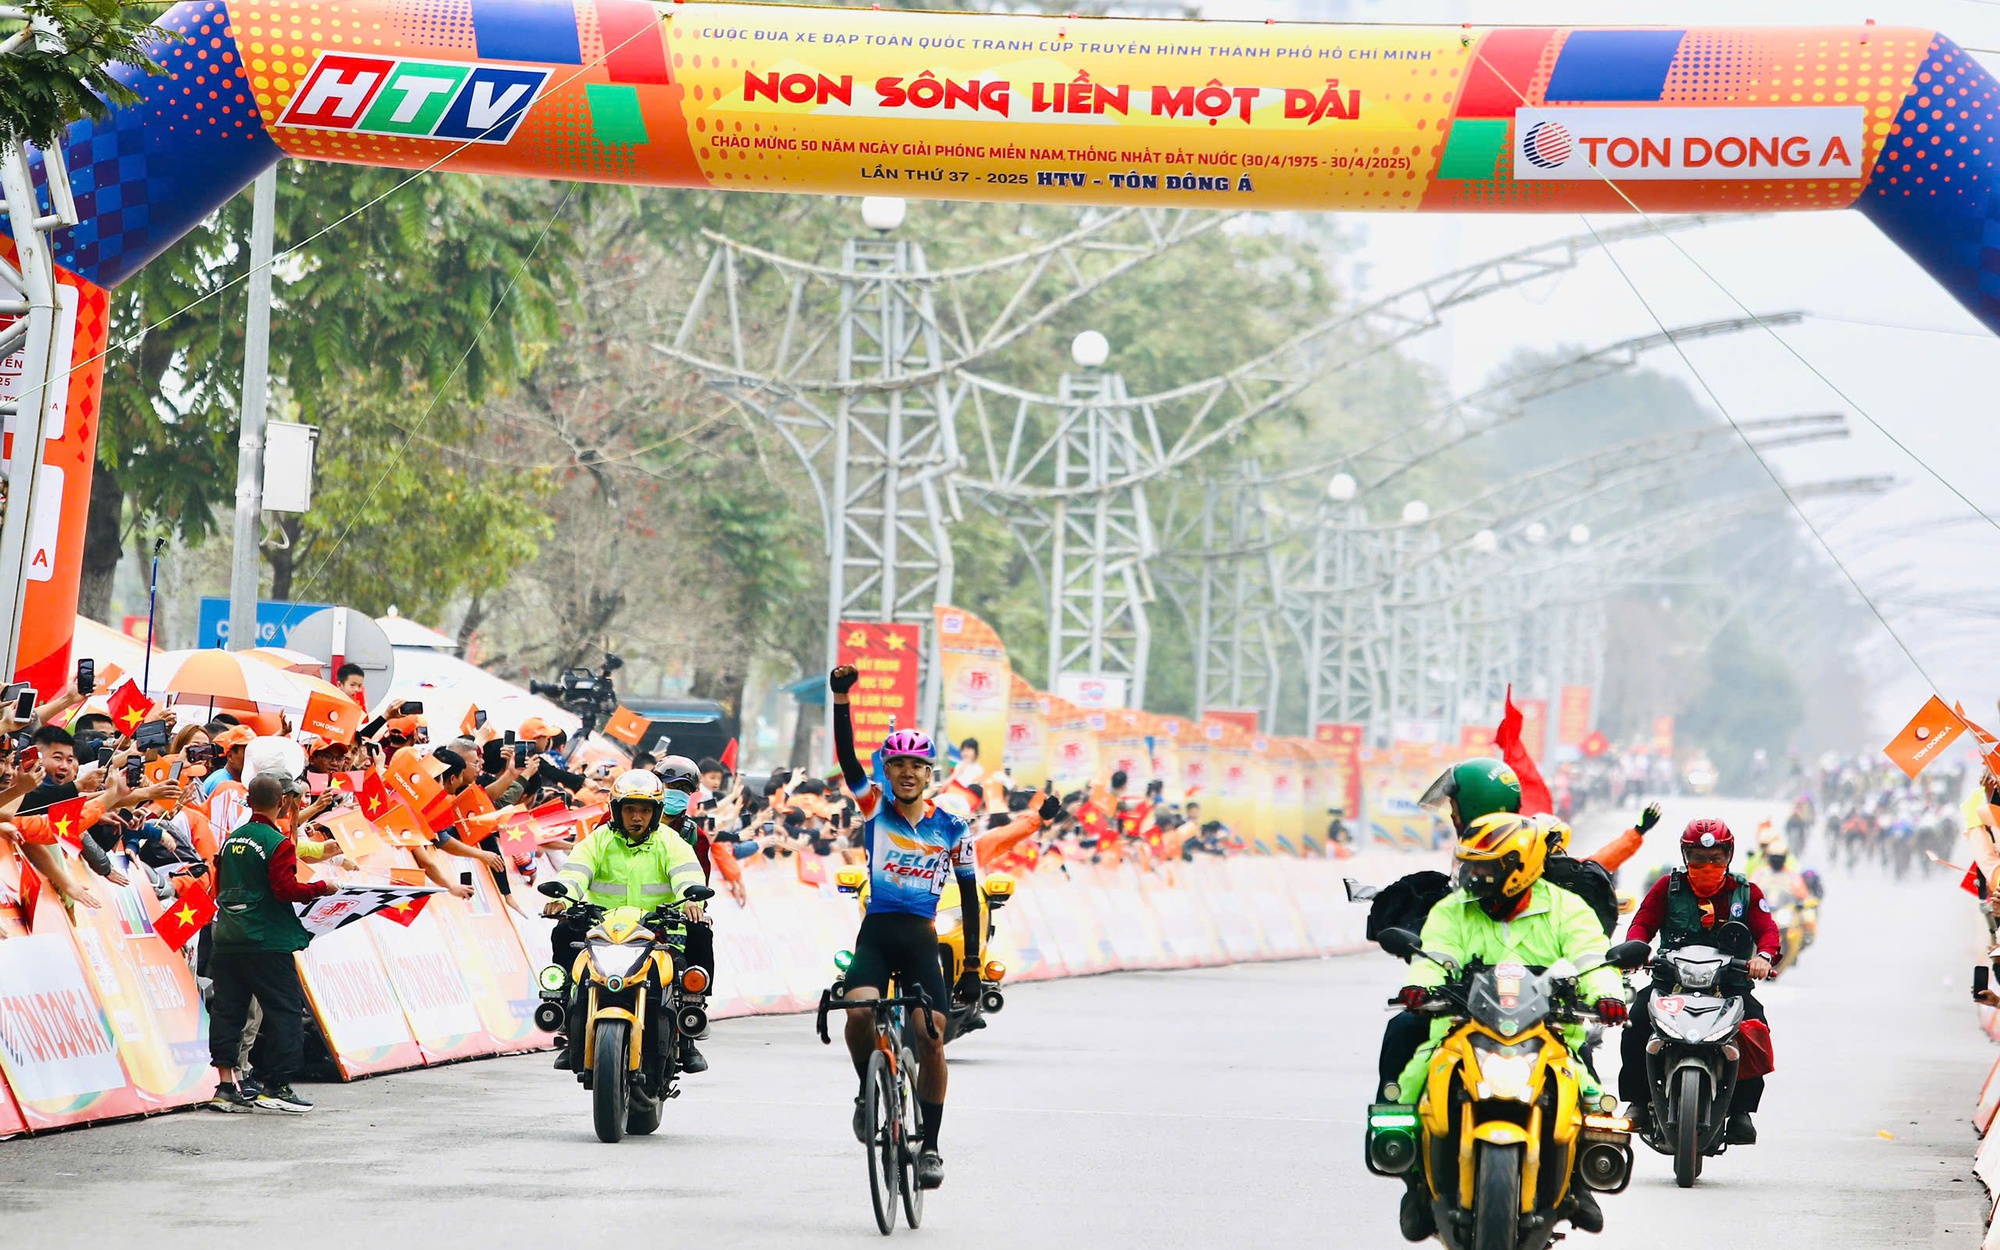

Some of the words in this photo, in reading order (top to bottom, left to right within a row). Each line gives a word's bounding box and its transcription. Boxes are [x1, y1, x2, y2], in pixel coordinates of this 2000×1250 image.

[702, 26, 749, 40] CUỘC
[754, 30, 790, 42] ĐUA
[796, 32, 817, 43] XE
[823, 33, 860, 46] ĐẠP
[864, 31, 914, 47] TOÀN
[972, 39, 1034, 51] TRANH
[1039, 37, 1074, 52] CÚP
[1157, 41, 1202, 56] HÌNH
[1208, 43, 1271, 58] THÀNH
[1349, 46, 1378, 60] CHÍ
[1383, 49, 1432, 61] MINH
[298, 66, 531, 129] HTV
[743, 69, 853, 107] NON
[875, 69, 1011, 119] SÔNG
[1031, 69, 1130, 116] LIỀN
[1150, 78, 1260, 126] MỘT
[1284, 78, 1362, 126] DẢI
[711, 134, 751, 149] CHÀO
[754, 136, 797, 151] MỪNG
[801, 139, 818, 152] 50
[822, 138, 855, 153] NĂM
[860, 140, 899, 155] NGÀY
[903, 141, 932, 156] GIẢI
[935, 142, 986, 159] PHÓNG
[990, 143, 1027, 160] MIỀN
[1068, 146, 1118, 163] THỐNG
[1121, 147, 1162, 164] NHẤT
[1165, 148, 1195, 165] ĐẤT
[1198, 150, 1238, 166] NƯỚC
[1242, 154, 1318, 169] (30/4/1975
[1331, 156, 1412, 171] 30/4/2025)
[1579, 136, 1672, 169] TON
[1683, 136, 1811, 169] DONG
[1818, 137, 1852, 167] A
[861, 163, 899, 181] LẦN
[905, 167, 944, 182] THỨ
[949, 172, 969, 182] 37
[987, 173, 1029, 185] 2025
[1037, 171, 1087, 188] HTV
[1108, 171, 1158, 189] TÔN
[1165, 172, 1230, 192] ĐÔNG
[1237, 173, 1255, 192] Á
[32, 549, 48, 568] A
[1912, 745, 1928, 761] TON
[1925, 729, 1946, 749] DONG
[393, 771, 405, 783] TON
[401, 781, 416, 796] DONG
[232, 845, 247, 855] VCF
